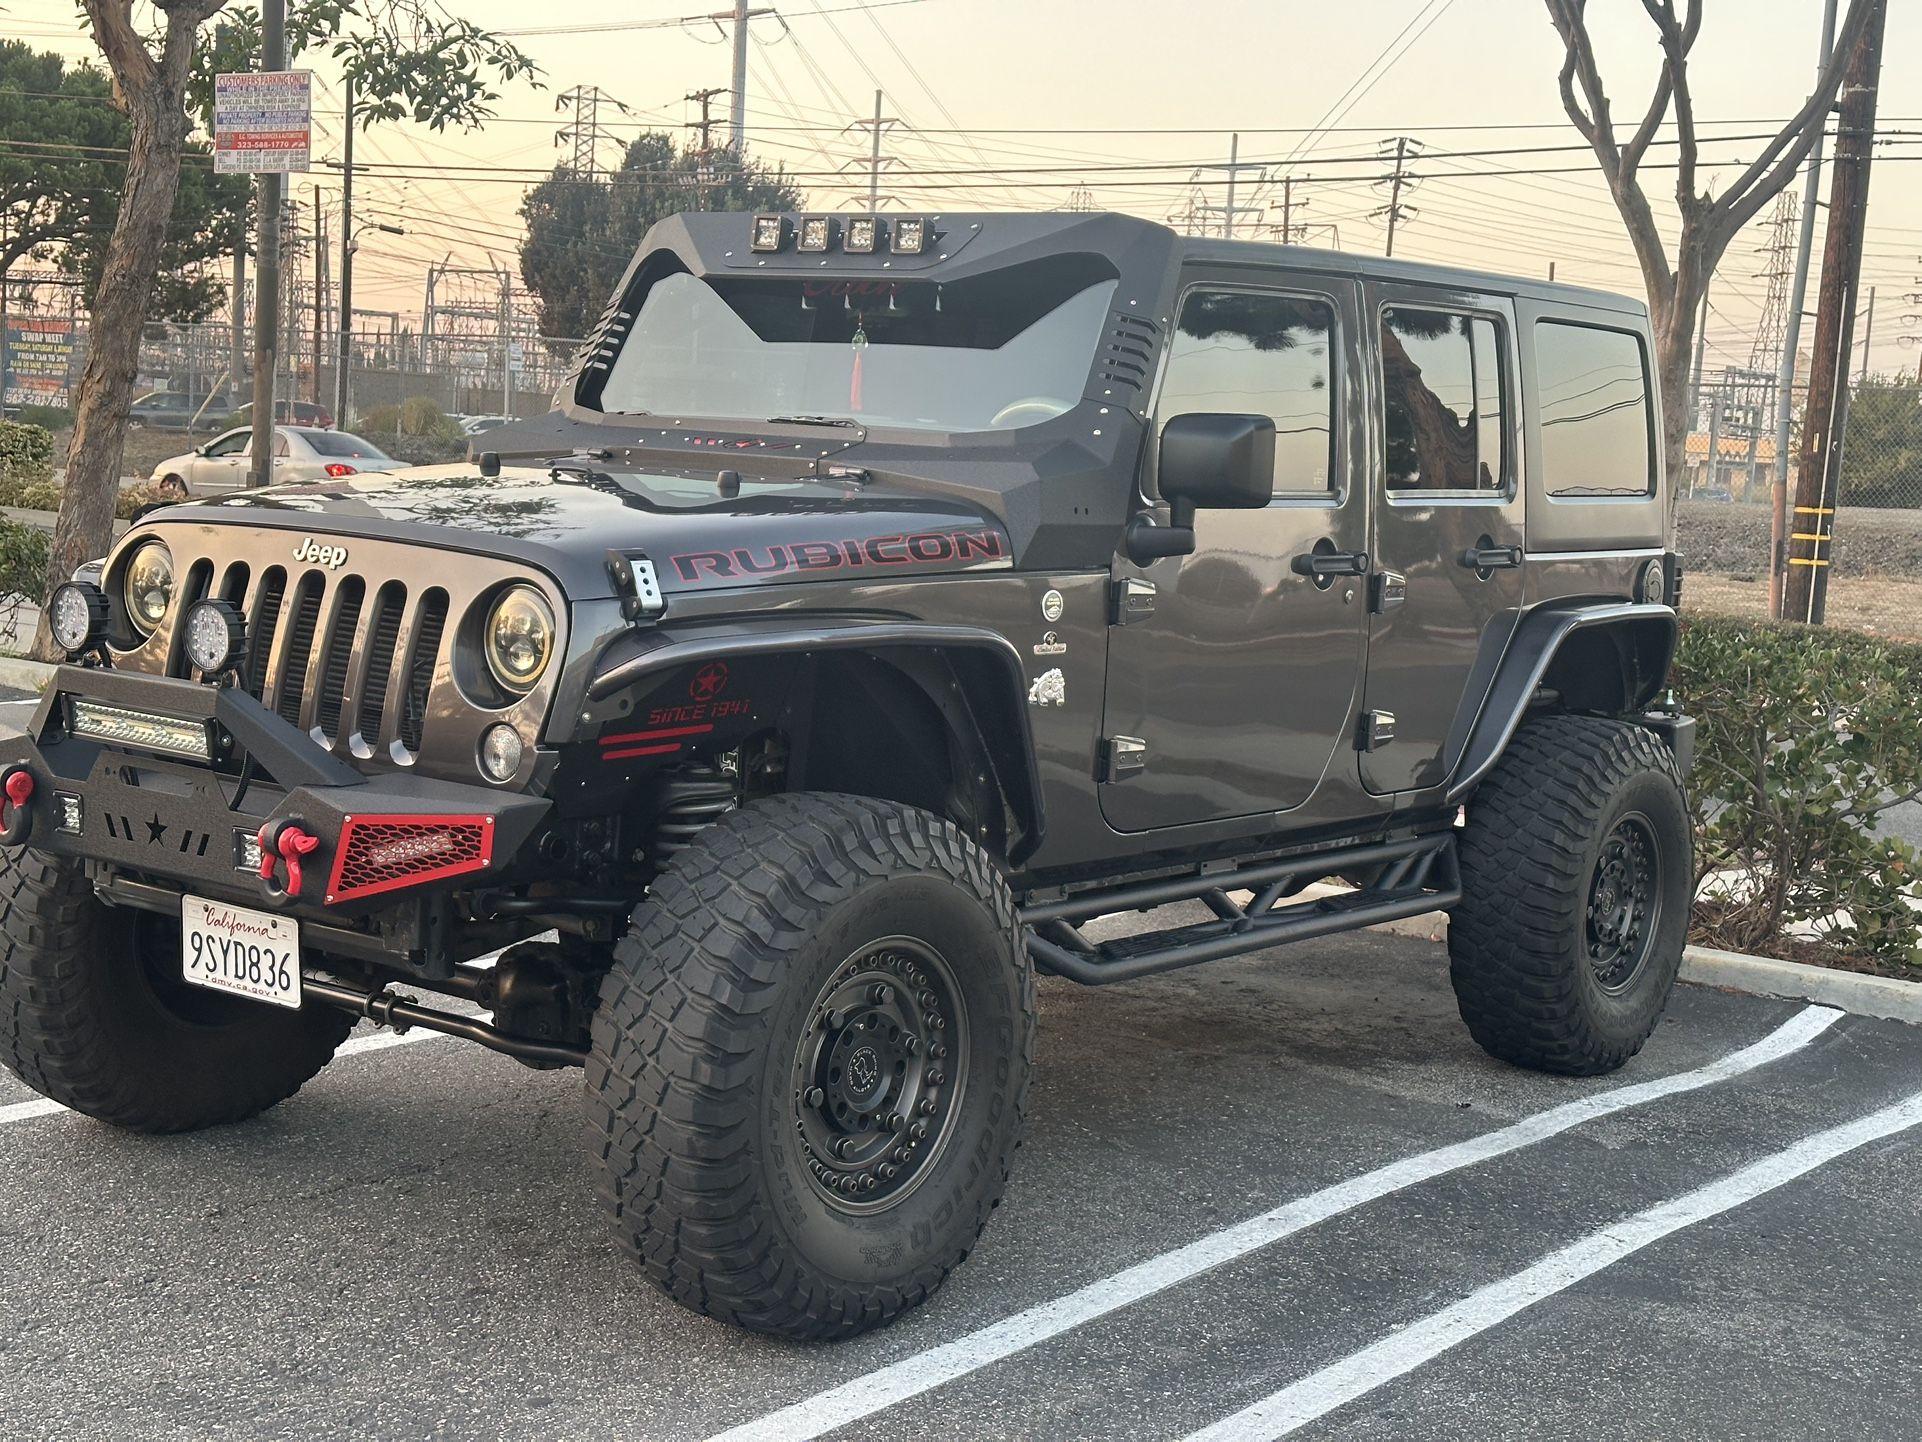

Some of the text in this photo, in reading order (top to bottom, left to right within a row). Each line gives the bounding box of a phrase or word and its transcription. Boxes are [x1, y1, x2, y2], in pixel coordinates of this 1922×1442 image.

[218, 74, 306, 87] CUSTOMERS PARKING ONLY
[21, 332, 63, 343] SWAP MEET
[17, 352, 35, 360] FROM
[48, 354, 55, 362] TO
[292, 537, 348, 570] Jeep
[669, 530, 1001, 583] RUBICON
[648, 699, 751, 725] SINCE 1941
[205, 907, 277, 940] California
[190, 931, 291, 991] 9SYD836
[211, 977, 271, 997] dmv.ca.gov
